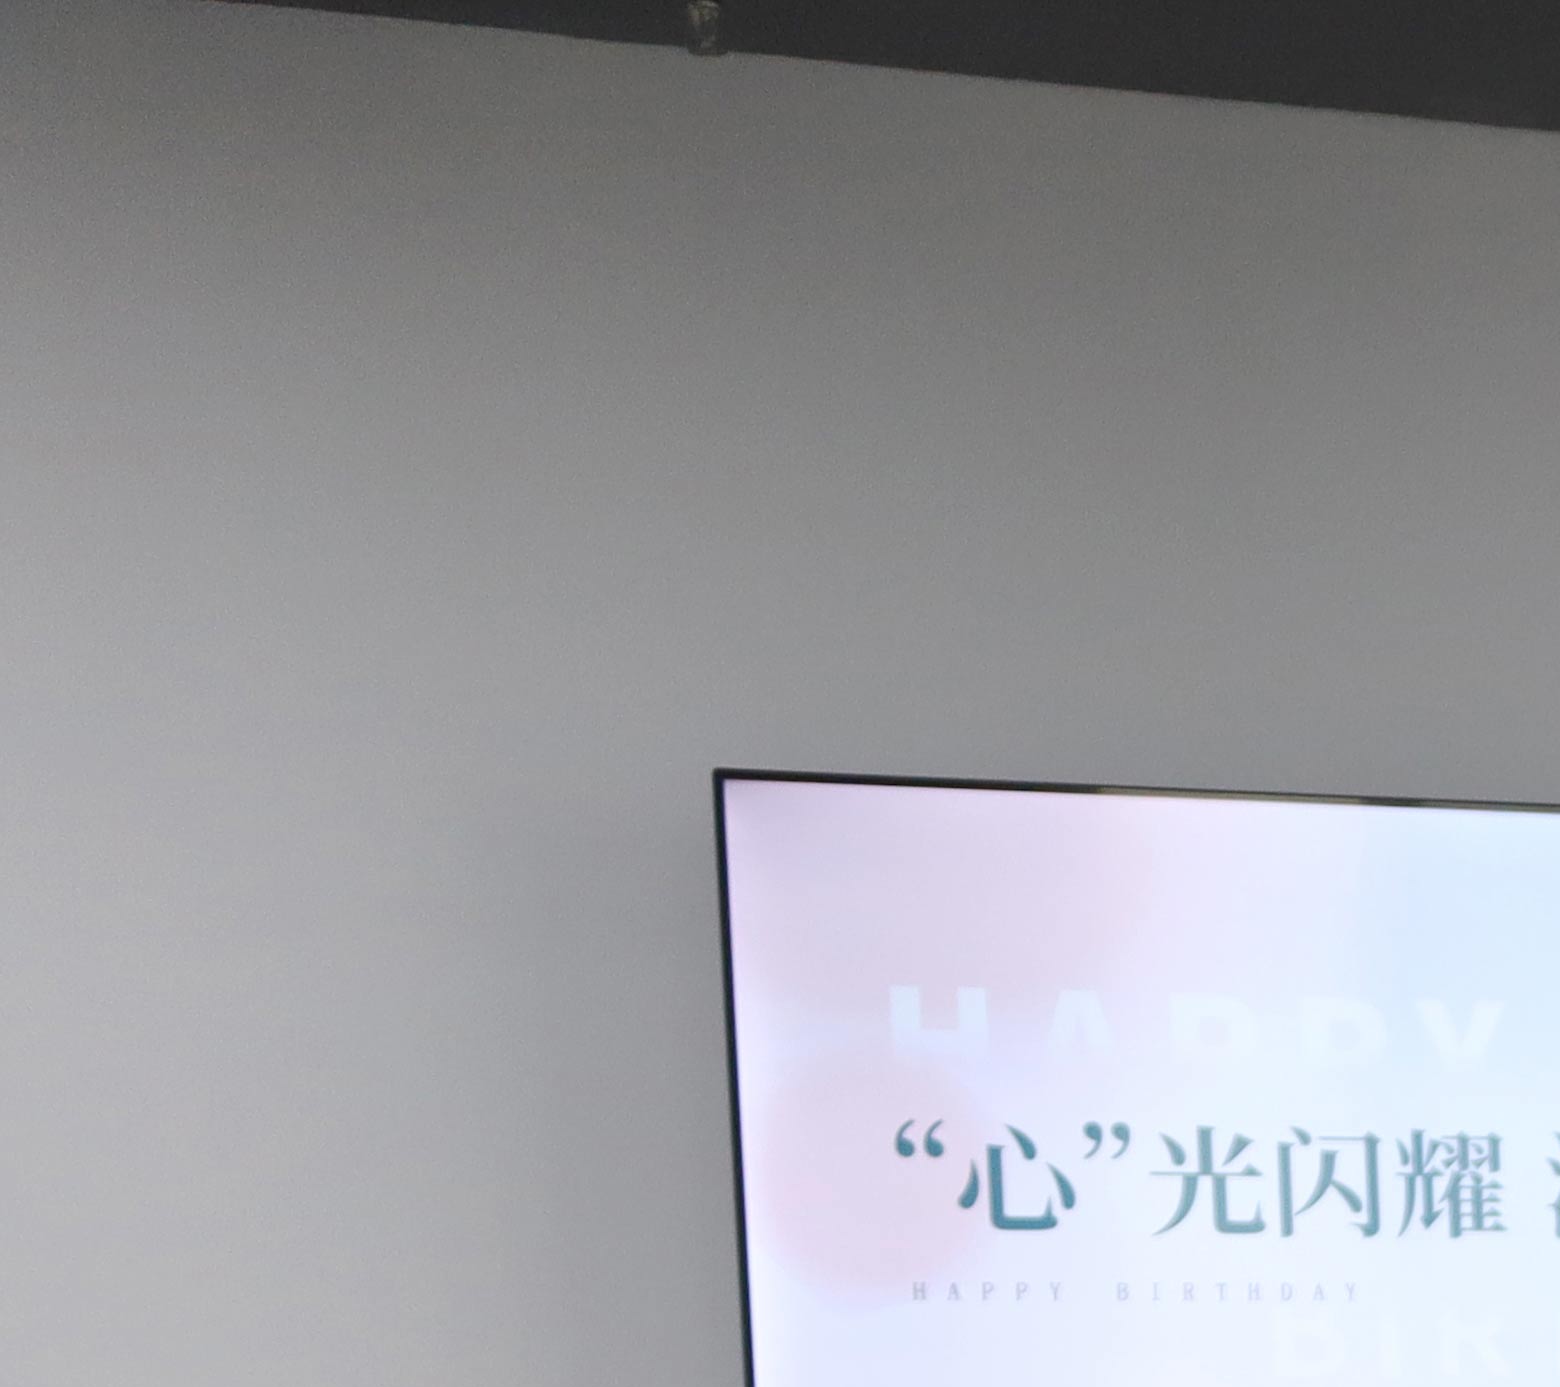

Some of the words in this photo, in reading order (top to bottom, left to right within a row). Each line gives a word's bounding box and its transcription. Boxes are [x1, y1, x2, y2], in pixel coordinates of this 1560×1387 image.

[893, 1118, 1508, 1239] “心”光闪耀
[912, 1281, 1064, 1302] HAPPY
[1116, 1281, 1360, 1302] BIRTHDAY
